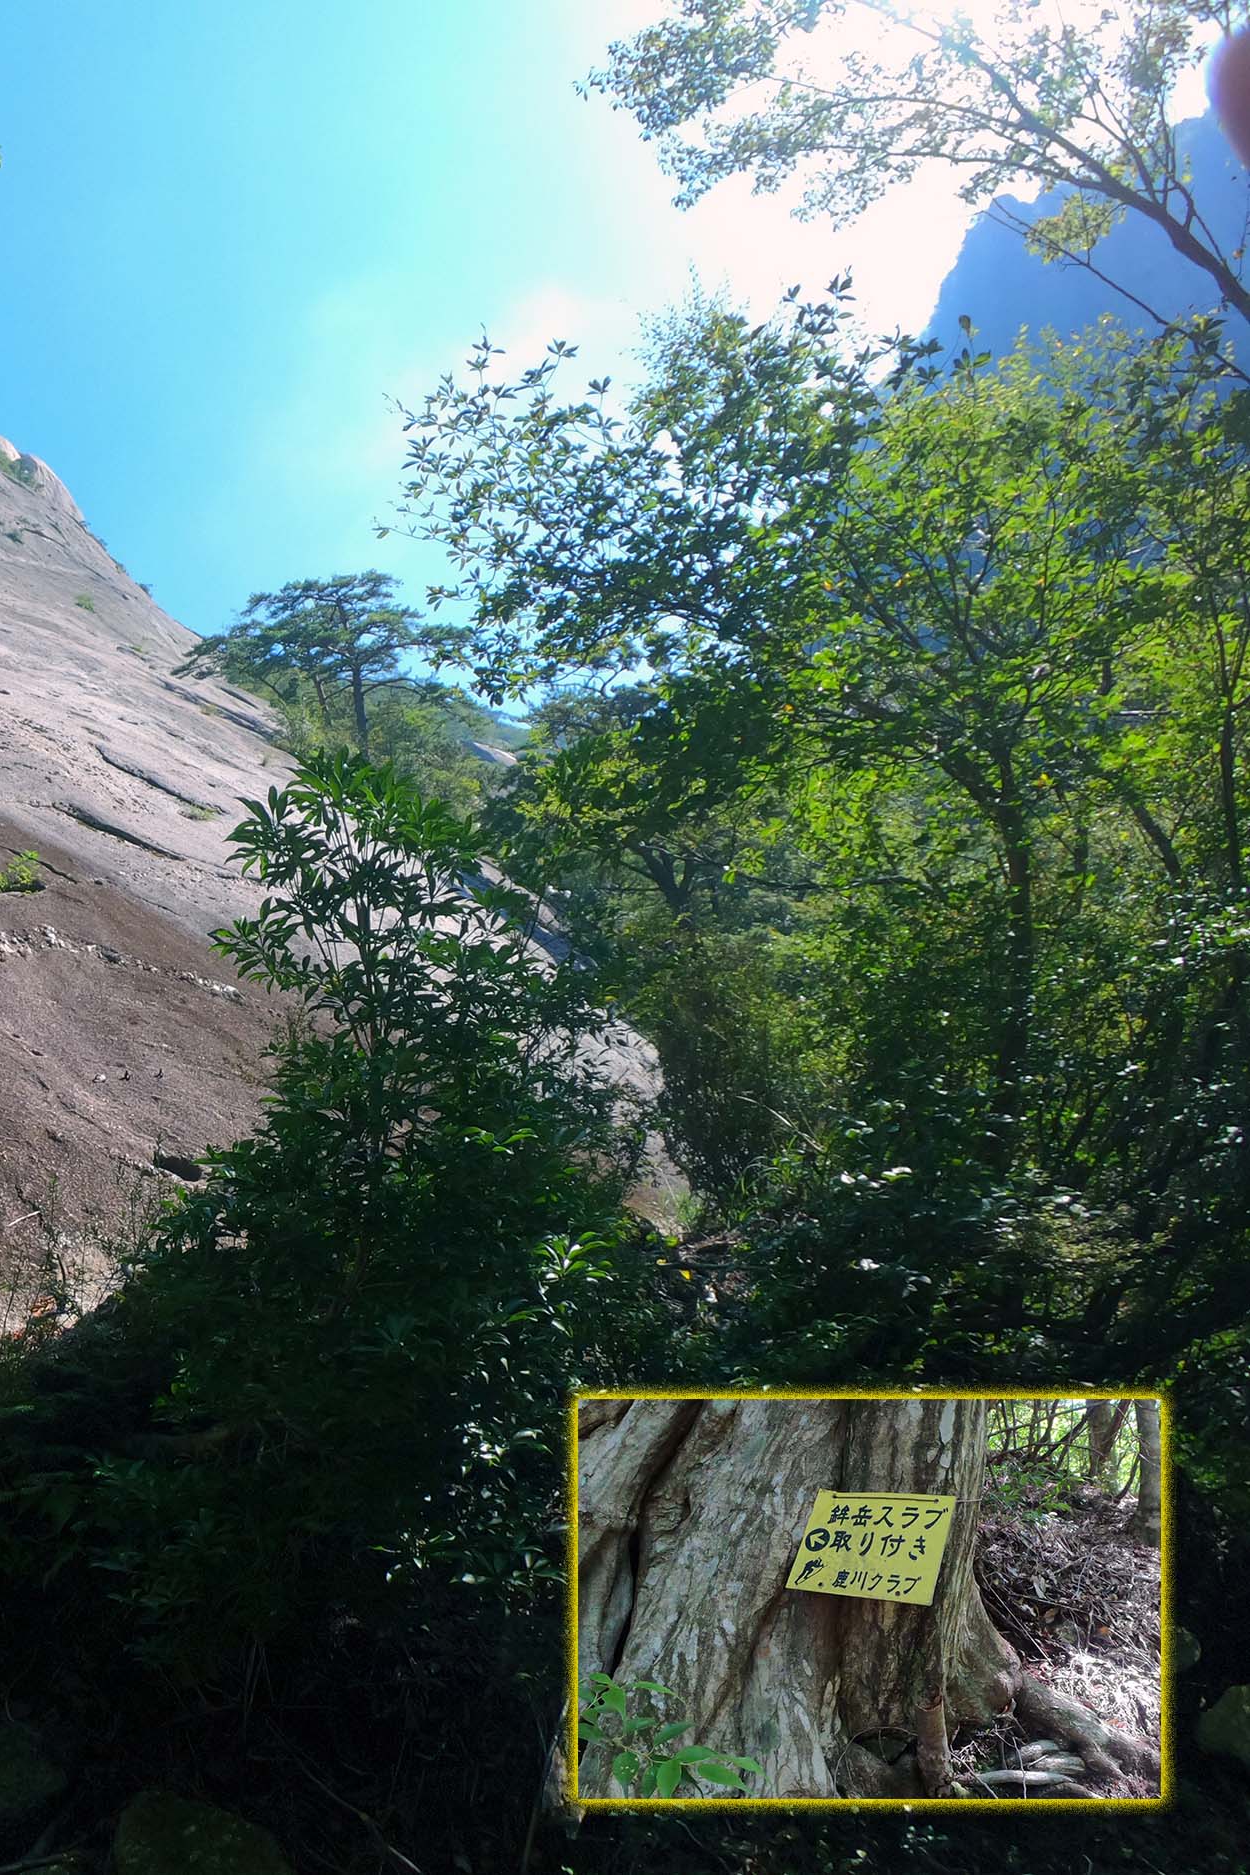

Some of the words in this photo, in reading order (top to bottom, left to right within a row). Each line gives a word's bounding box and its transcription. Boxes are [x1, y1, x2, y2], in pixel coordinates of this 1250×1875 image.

[827, 1504, 949, 1530] 鉾岳スラブ
[829, 1530, 927, 1560] 取り付き
[832, 1569, 922, 1595] 鹿川クラブ
